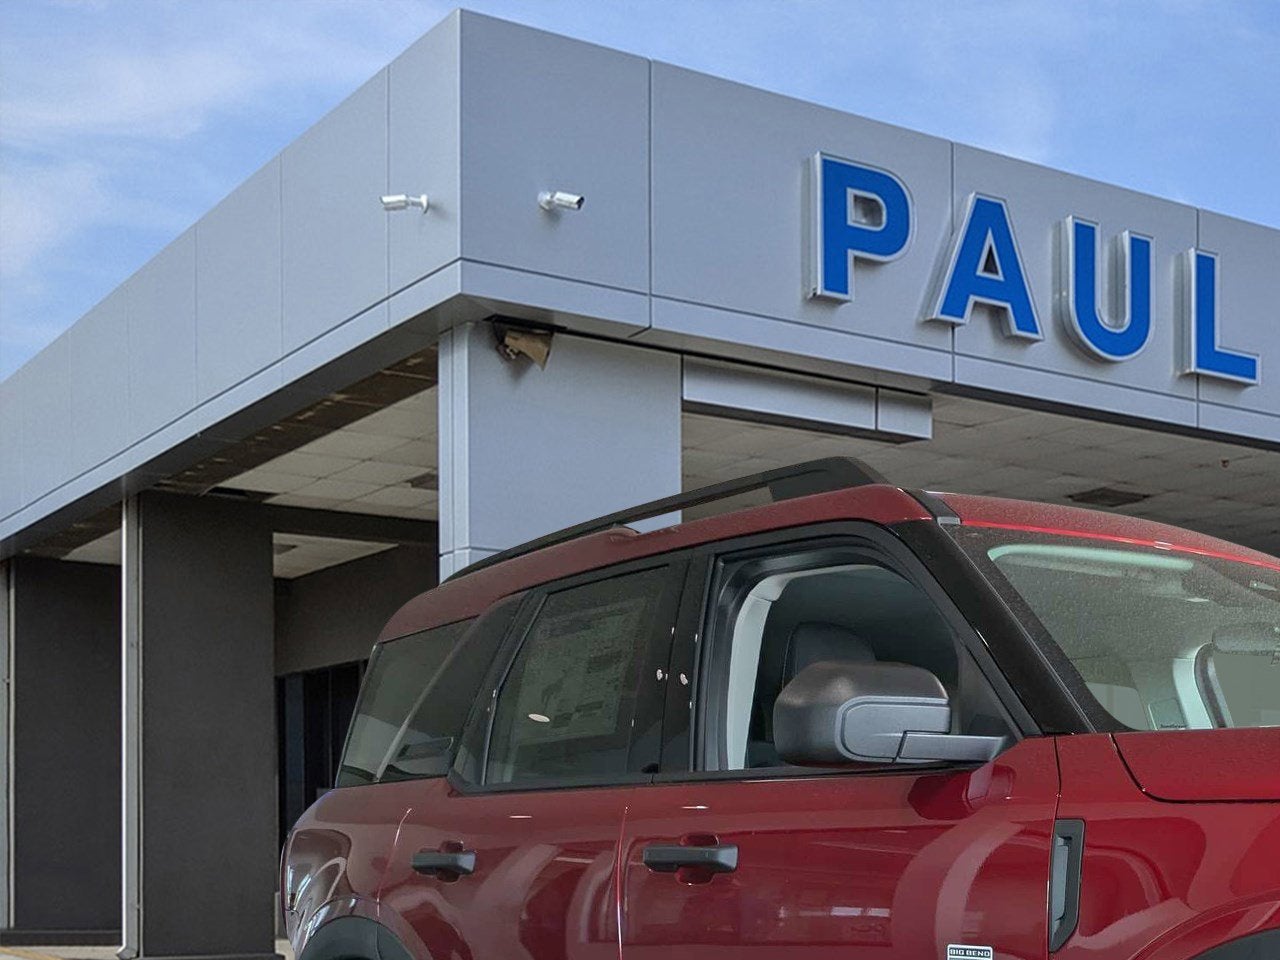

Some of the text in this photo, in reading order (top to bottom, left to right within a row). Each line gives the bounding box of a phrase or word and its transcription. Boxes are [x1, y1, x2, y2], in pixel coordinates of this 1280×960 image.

[813, 153, 1259, 386] PAUL
[949, 948, 990, 957] BIG BEND
